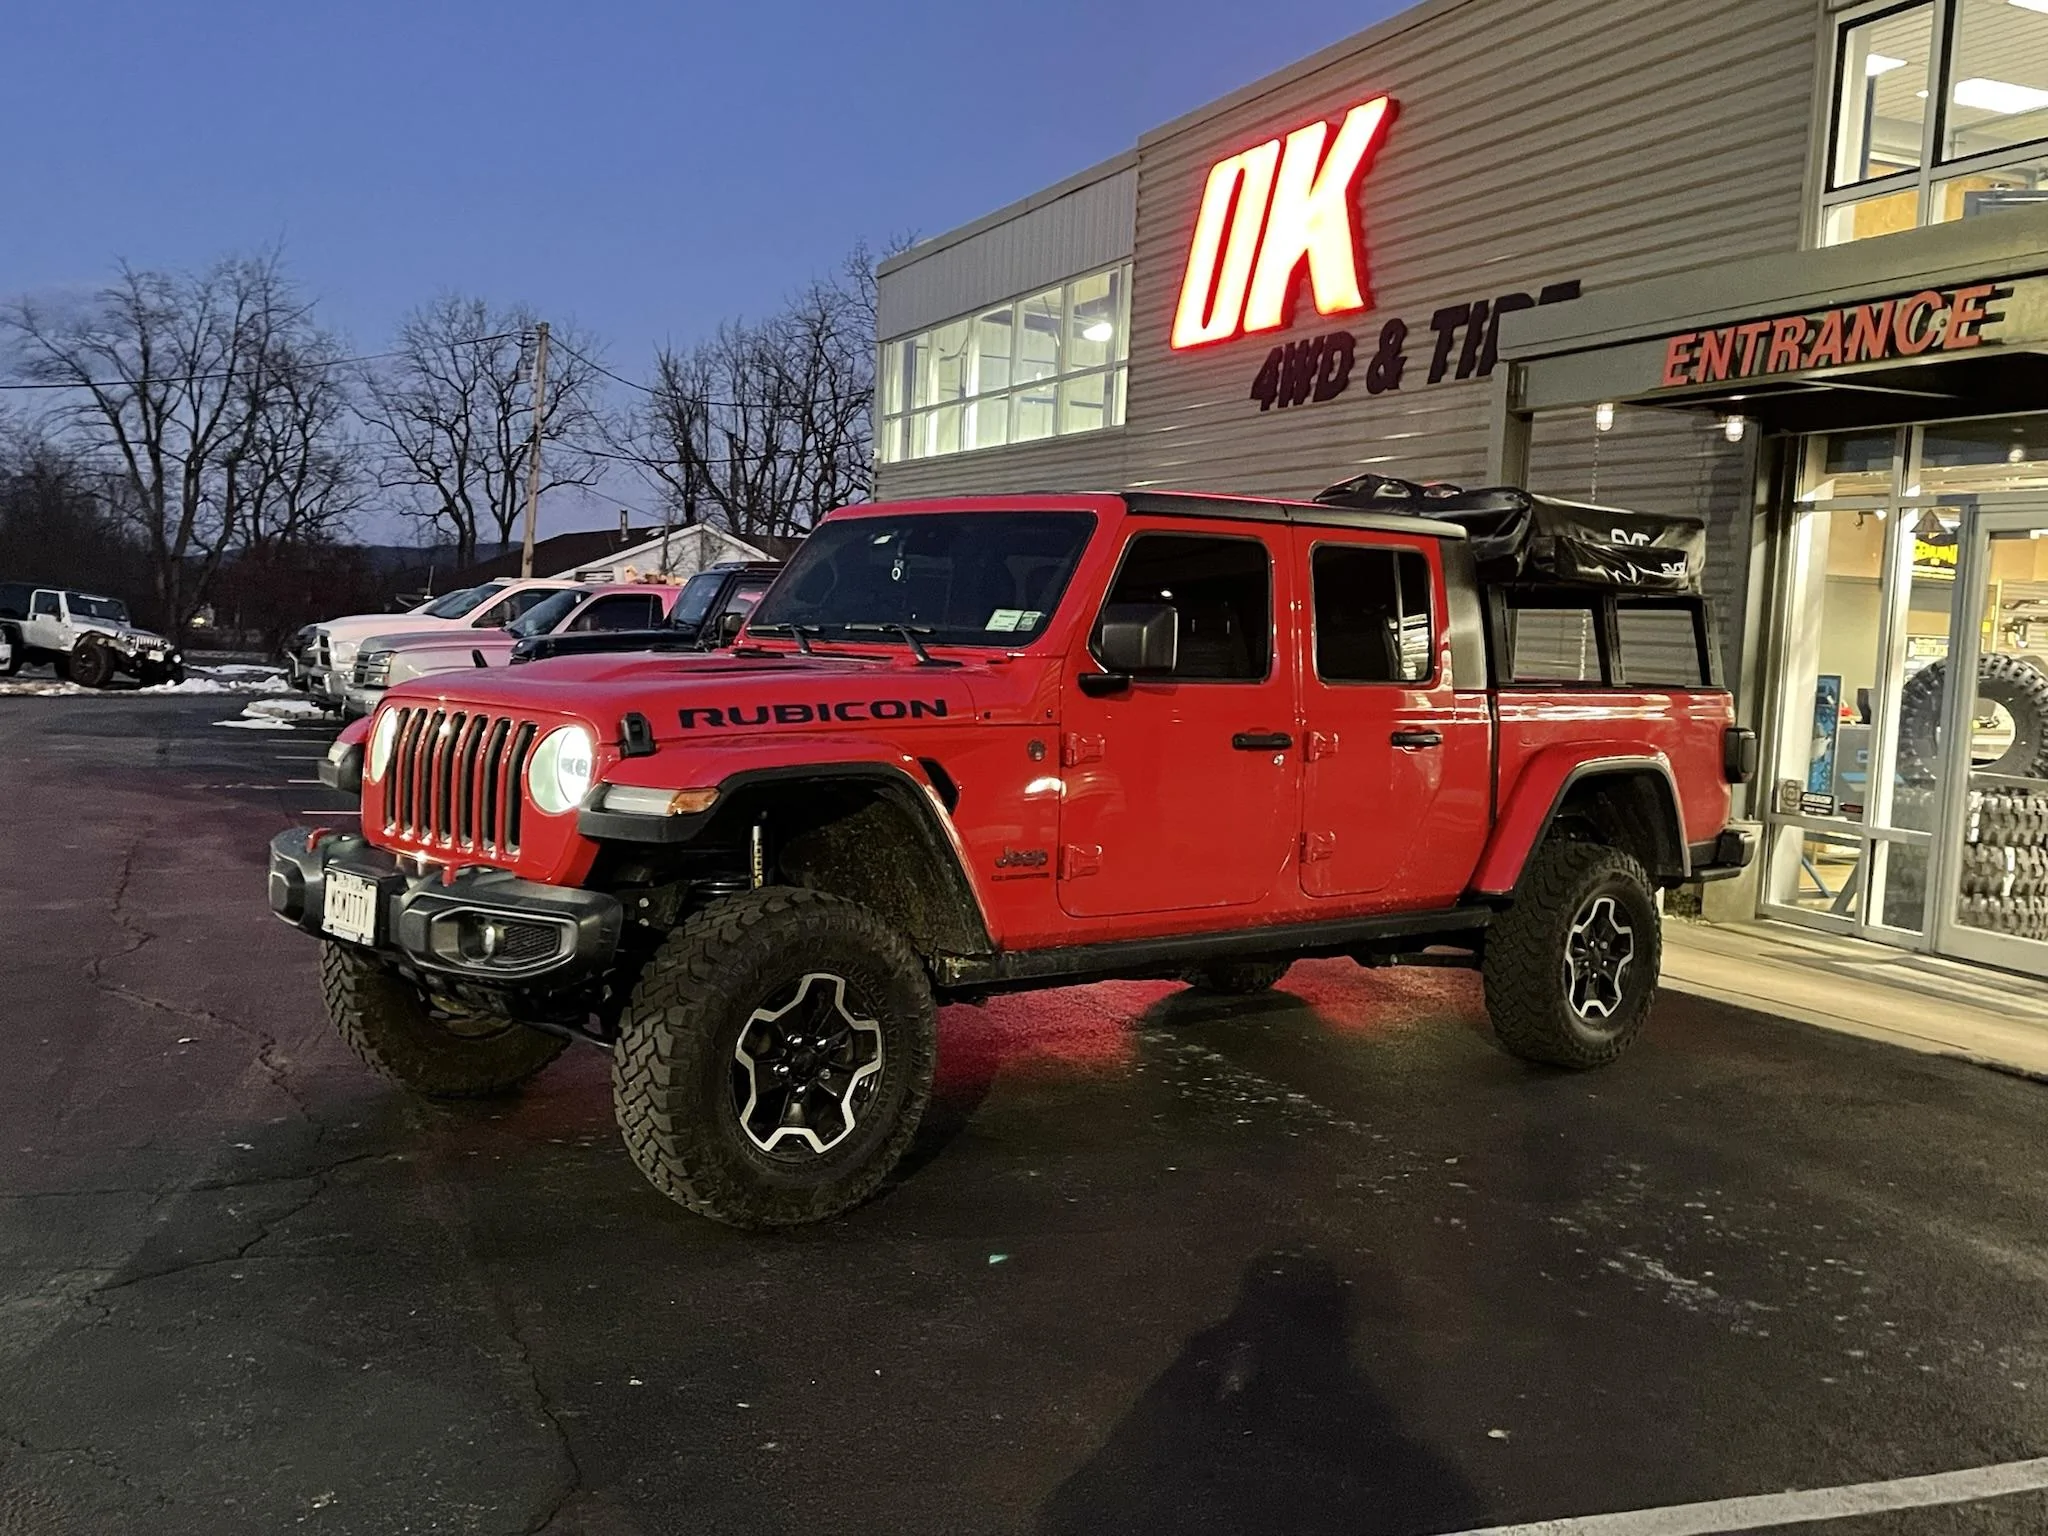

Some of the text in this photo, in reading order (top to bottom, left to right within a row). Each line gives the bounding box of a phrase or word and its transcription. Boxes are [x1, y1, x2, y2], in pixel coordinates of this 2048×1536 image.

[1170, 95, 1393, 350] OK
[1250, 280, 1581, 411] 4WD & TI
[1660, 284, 1996, 387] ENTRANCE
[678, 699, 948, 729] RUBICON
